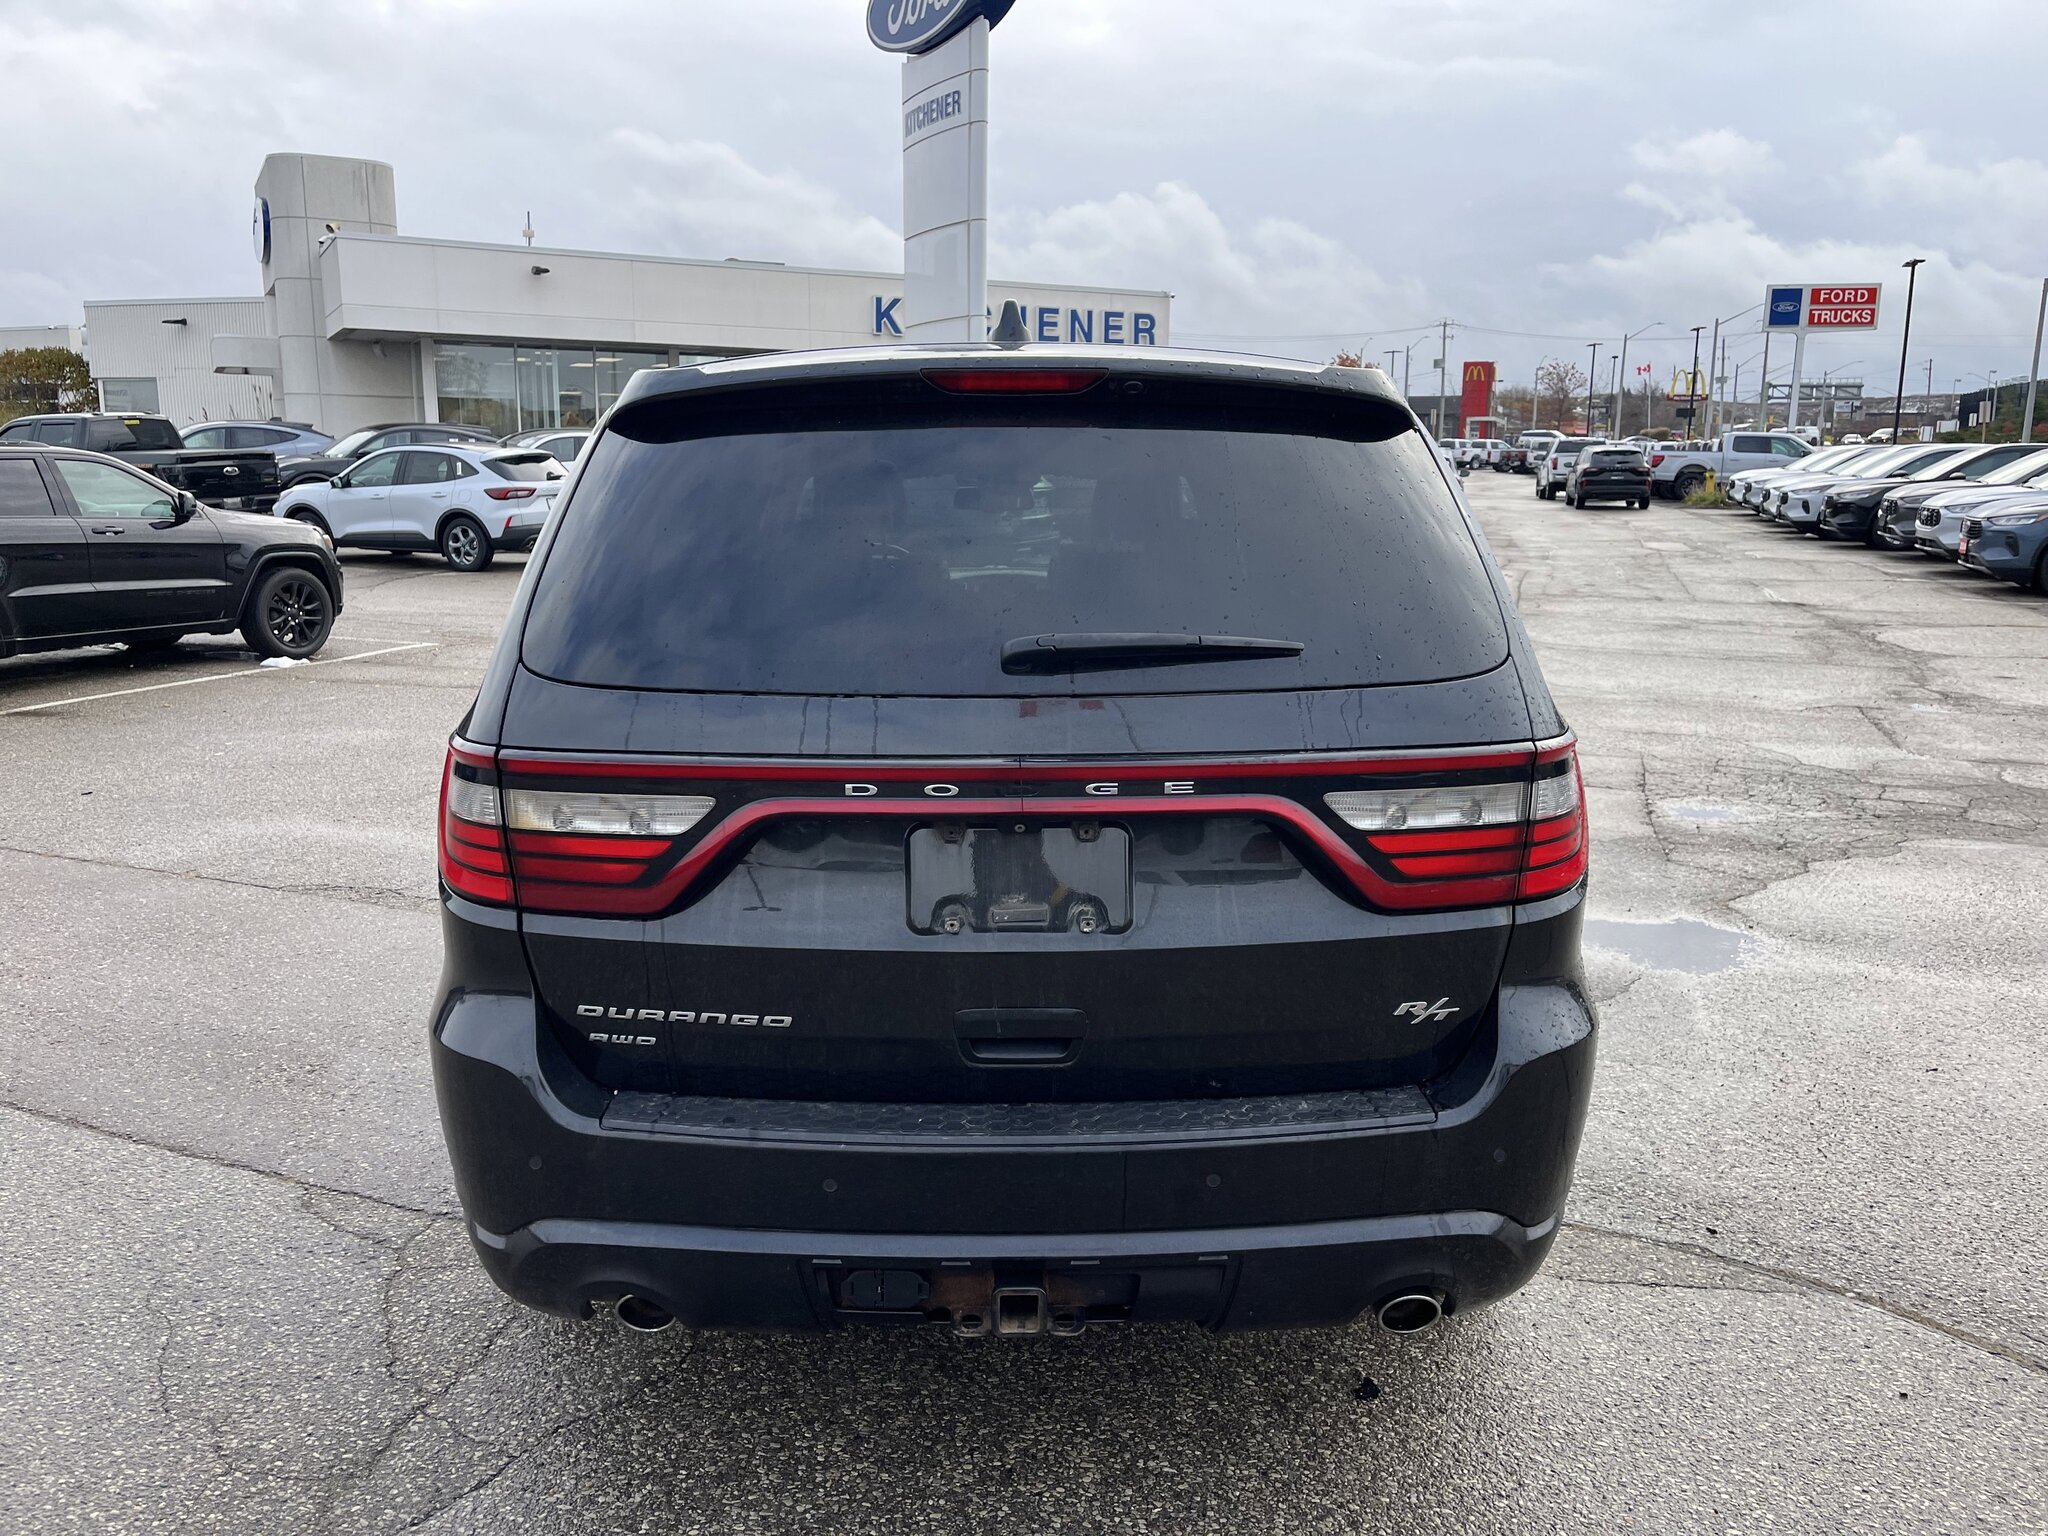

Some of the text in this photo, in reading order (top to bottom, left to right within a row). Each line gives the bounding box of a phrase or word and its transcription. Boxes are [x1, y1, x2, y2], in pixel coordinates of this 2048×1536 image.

[904, 90, 961, 137] KITCHENER
[1819, 289, 1868, 303] FORD
[873, 296, 1156, 345] KENER
[1812, 309, 1871, 323] TRUCKS
[575, 1004, 793, 1028] DURANGO
[1392, 996, 1460, 1024] R/T
[588, 1032, 656, 1046] AWD
